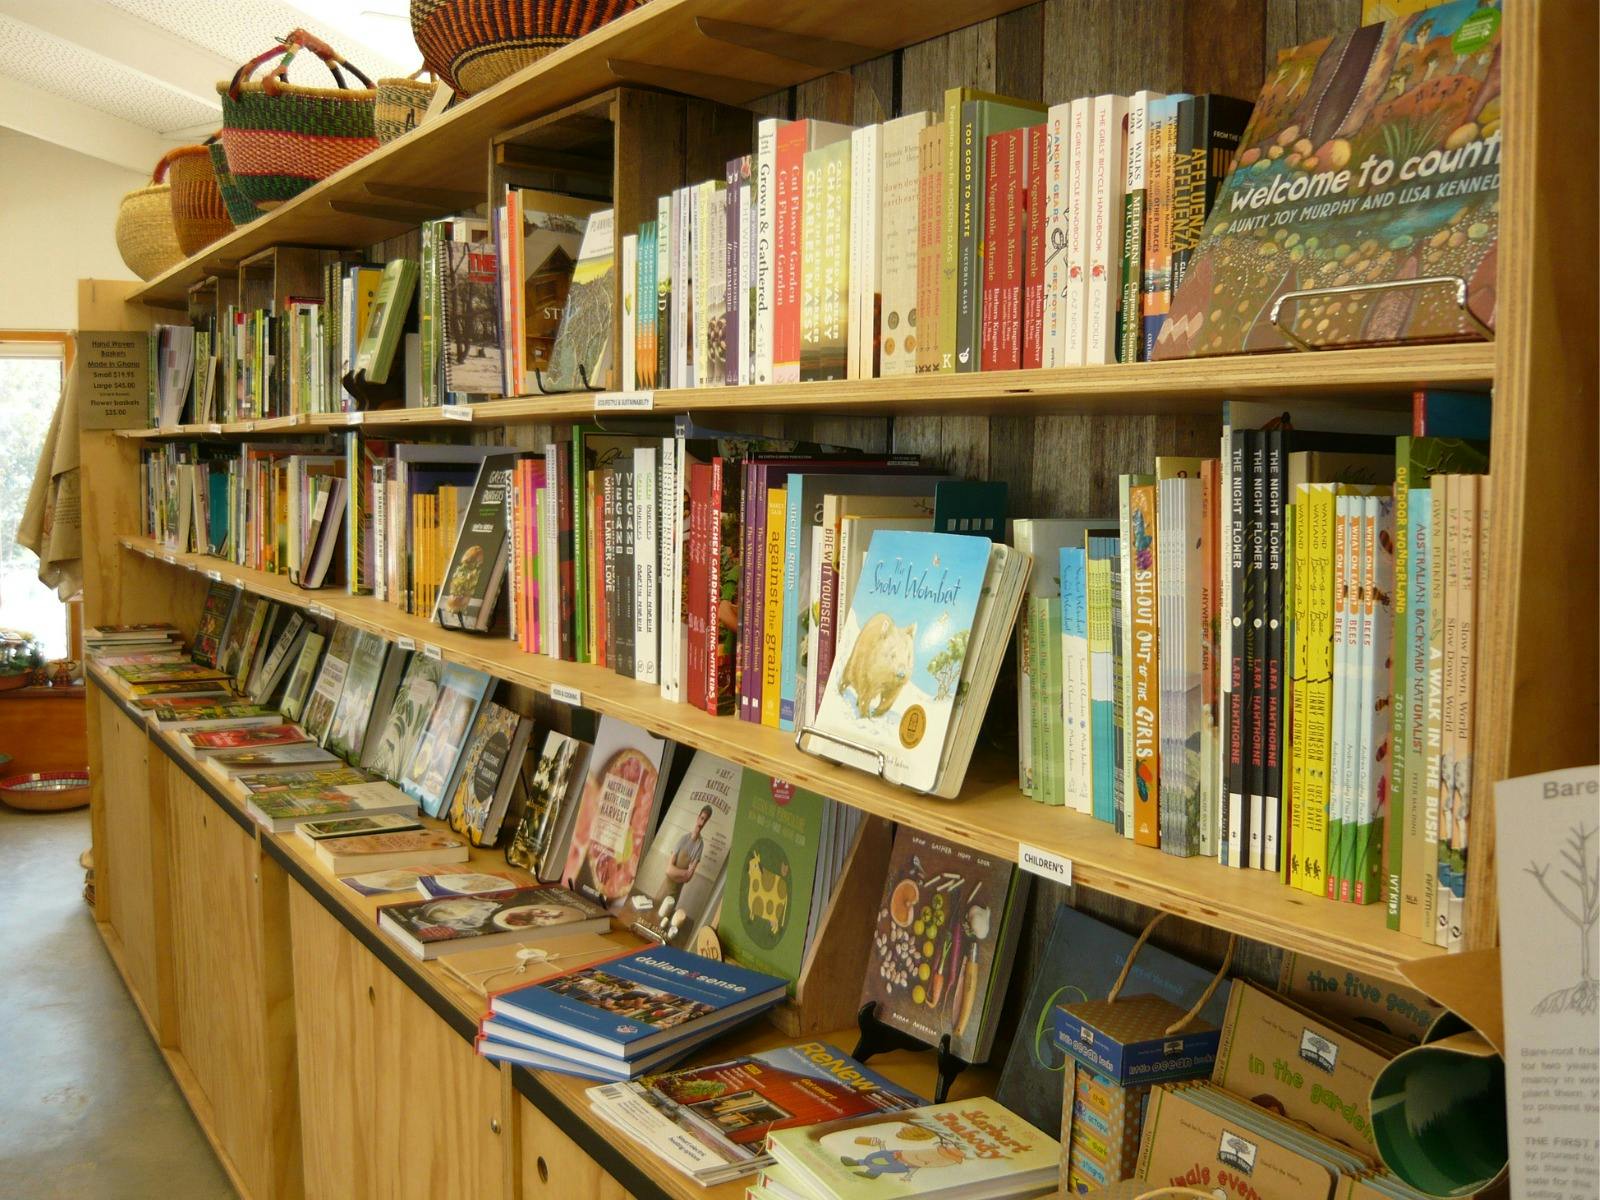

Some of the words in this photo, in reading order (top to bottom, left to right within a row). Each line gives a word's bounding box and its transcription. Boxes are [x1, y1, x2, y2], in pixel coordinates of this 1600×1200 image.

[1135, 107, 1144, 131] DAY
[1031, 131, 1040, 174] Animal,
[1135, 141, 1143, 180] WALKS
[760, 163, 770, 217] Grown
[790, 165, 799, 190] Cut
[965, 184, 971, 199] TO
[1097, 158, 1105, 194] BICYCLE
[1230, 168, 1350, 214] welcome
[1358, 154, 1394, 186] to
[825, 162, 835, 257] CHARLES
[1029, 177, 1040, 233] Vegetable,
[1172, 153, 1191, 253] AFFLUENZA
[1187, 148, 1206, 250] AFFLUENZA
[1228, 215, 1270, 234] AUNTY
[1271, 208, 1298, 227] JOY
[1300, 199, 1360, 221] MURPHY
[1362, 191, 1392, 210] AND
[1400, 185, 1429, 205] LISA
[760, 222, 769, 232] &
[789, 196, 799, 248] Flower
[1095, 197, 1103, 252] HANDBOOK
[1124, 203, 1132, 259] VICTORIA
[1131, 197, 1141, 267] MELBOURNE
[1030, 236, 1038, 277] Miracle
[789, 251, 798, 303] Garden
[824, 268, 833, 340] MASSY
[1128, 282, 1137, 322] Chapman
[943, 354, 952, 368] K
[1233, 449, 1241, 472] THE
[1270, 450, 1278, 473] THE
[604, 476, 612, 515] WHOLE
[1233, 477, 1241, 514] NIGHT
[1270, 478, 1278, 516] NIGHT
[1396, 467, 1408, 525] OUTDOOR
[712, 509, 720, 556] KITCHEN
[788, 503, 797, 549] ancient
[824, 528, 834, 563] BREW
[1233, 521, 1241, 568] FLOWER
[1270, 522, 1278, 570] FLOWER
[711, 559, 719, 602] GARDEN
[769, 531, 782, 606] against
[785, 552, 797, 591] grains
[822, 564, 832, 574] IT
[1366, 555, 1372, 568] ON
[1396, 530, 1407, 614] WONDERLAND
[1416, 523, 1426, 604] AUSTRALIAN
[904, 562, 961, 605] Wombat
[1135, 569, 1153, 626] SHOUT
[769, 610, 777, 629] the
[820, 578, 832, 636] YOURSELF
[1202, 587, 1210, 640] ANYWHERE
[709, 605, 717, 651] COOKING
[1136, 630, 1153, 664] OUT
[1363, 621, 1371, 646] BEES
[1414, 608, 1426, 673] BACKYARD
[1447, 618, 1456, 648] Slow
[766, 635, 779, 685] grain
[1138, 665, 1148, 681] to
[1232, 657, 1241, 687] LARA
[1429, 647, 1441, 660] A
[1137, 682, 1147, 701] THE
[1269, 660, 1277, 690] LARA
[1427, 668, 1441, 719] WALK
[1294, 689, 1302, 714] JINNY
[1412, 678, 1424, 756] NATURALIST
[1445, 696, 1455, 733] World
[1231, 694, 1240, 764] HAWTHORNE
[1267, 697, 1276, 768] HAWTHORNE
[1293, 718, 1302, 758] JOHNSON
[1427, 728, 1439, 747] IN
[606, 779, 634, 797] AUSTRALIAN
[1293, 781, 1302, 802] LUCY
[1426, 755, 1438, 788] THE
[600, 803, 629, 823] HARVEST
[1292, 805, 1301, 828] DAVEY
[1425, 796, 1437, 844] BUSH
[1024, 852, 1064, 875] CHILDREN'S
[1307, 970, 1338, 992] the
[1344, 972, 1381, 1003] five
[795, 1042, 880, 1092] ReNew
[1248, 1054, 1265, 1076] in
[1273, 1057, 1303, 1088] the
